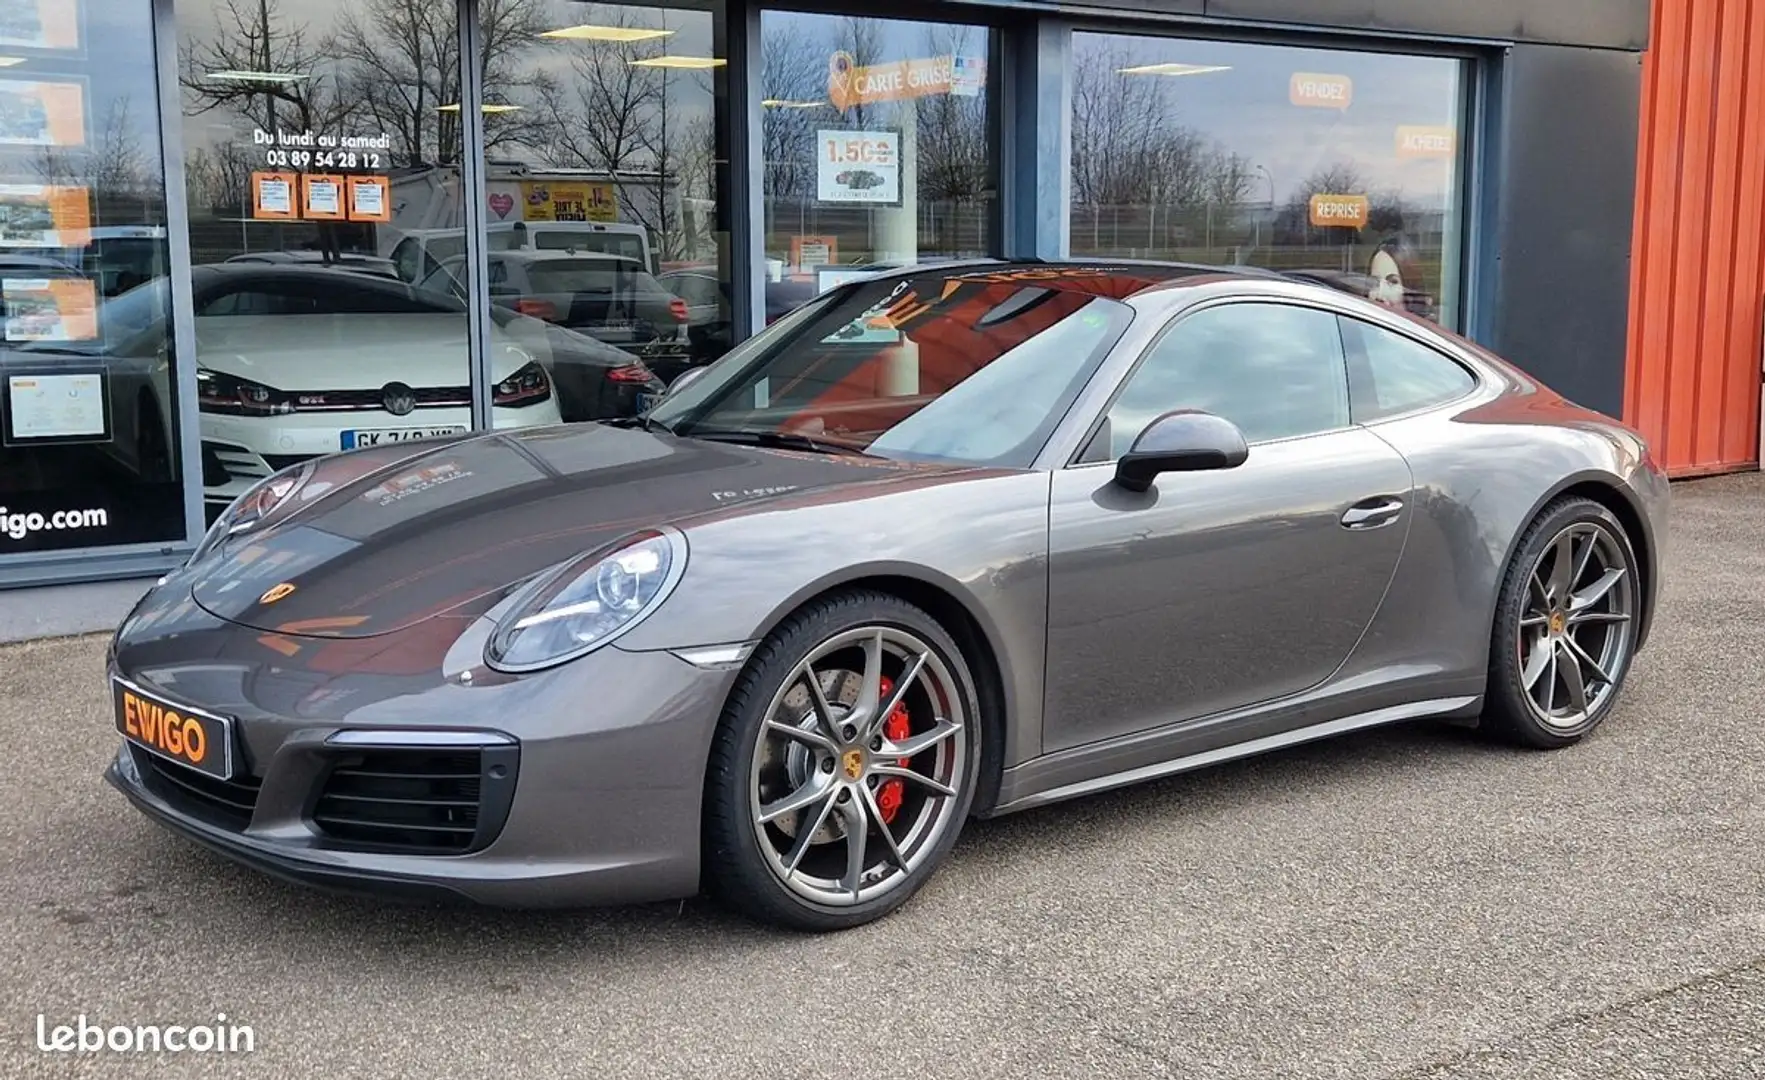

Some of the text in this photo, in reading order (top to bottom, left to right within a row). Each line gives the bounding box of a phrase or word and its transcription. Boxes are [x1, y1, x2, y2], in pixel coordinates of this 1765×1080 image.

[854, 72, 903, 95] CARTE
[907, 64, 951, 87] GRISE
[1297, 80, 1345, 100] VENDEZ
[254, 128, 390, 148] Du lundi au samedi
[267, 150, 380, 168] 03 89 54 28 12
[1316, 202, 1361, 219] REPRISE
[124, 692, 205, 762] EWIGO
